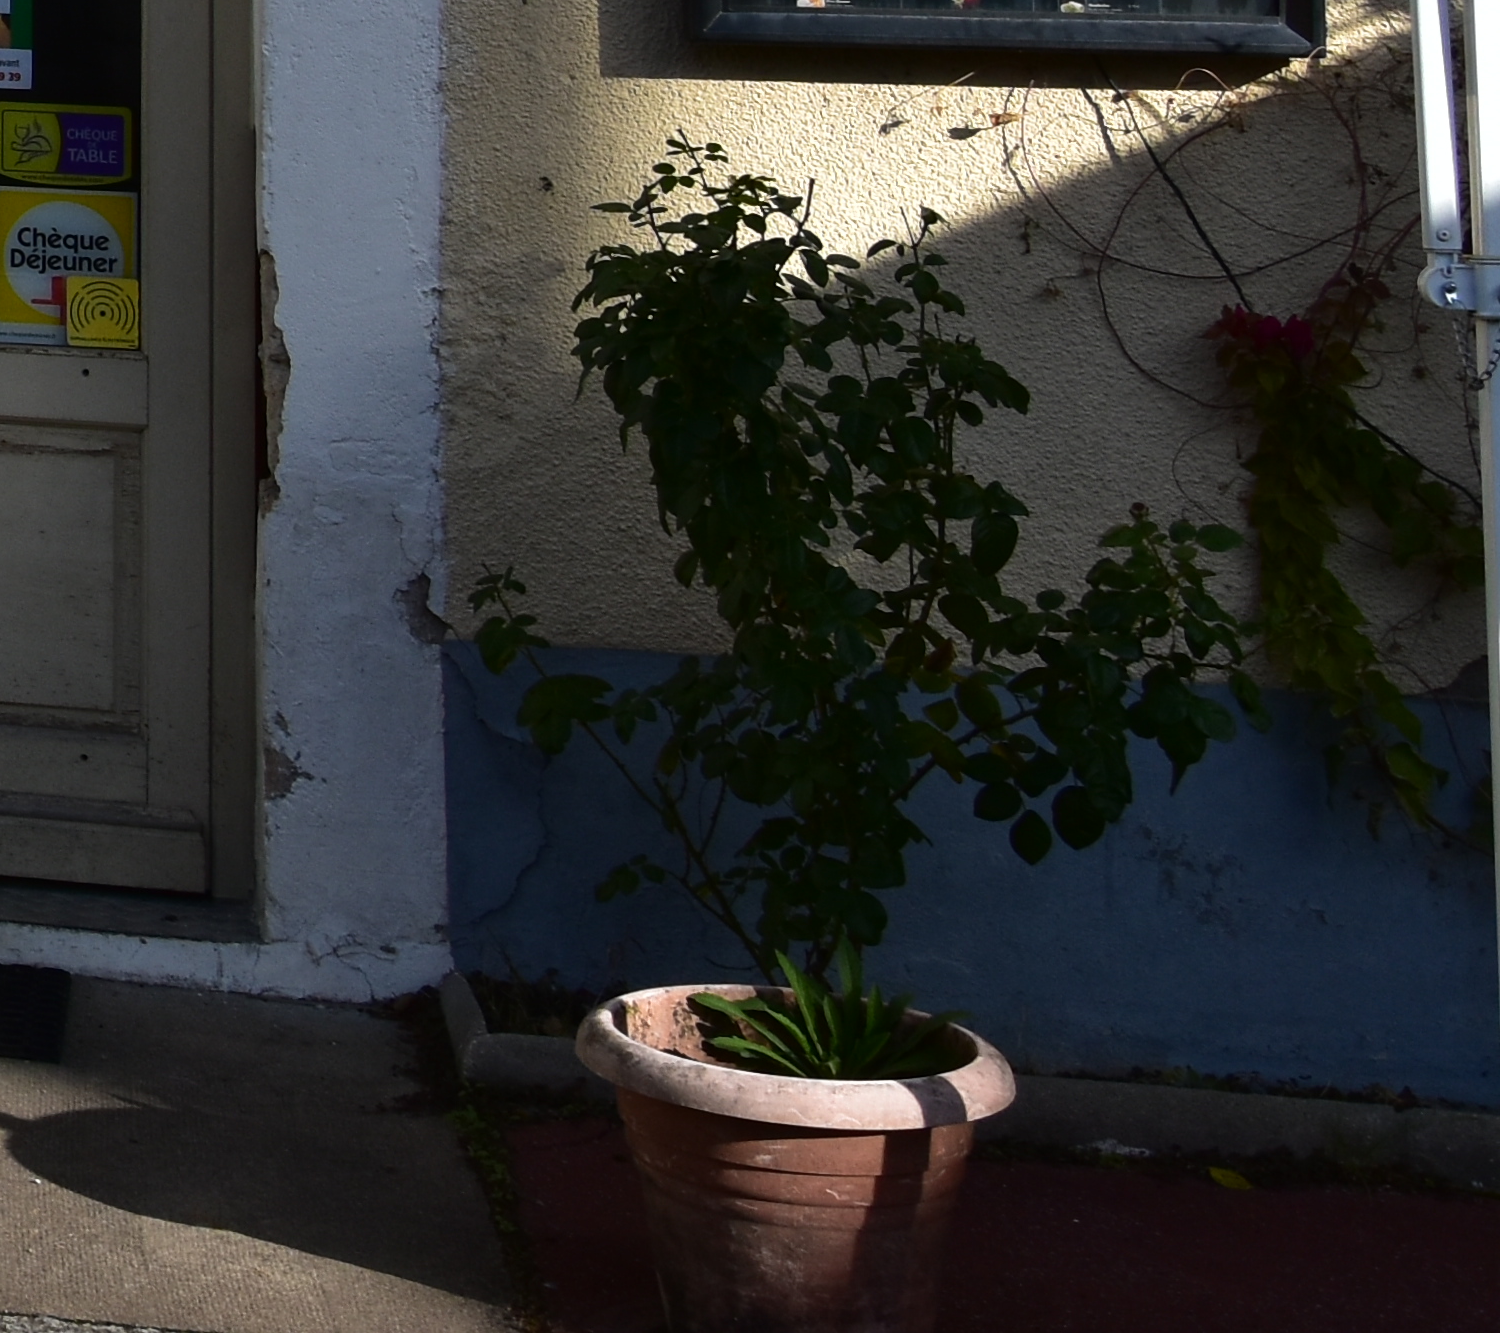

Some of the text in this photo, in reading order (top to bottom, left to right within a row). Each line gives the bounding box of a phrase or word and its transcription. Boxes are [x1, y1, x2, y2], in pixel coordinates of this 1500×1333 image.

[66, 126, 119, 143] CHÈQUE
[67, 147, 119, 165] TABLE
[17, 226, 110, 255] Chèque
[9, 247, 119, 274] Déjeuner
